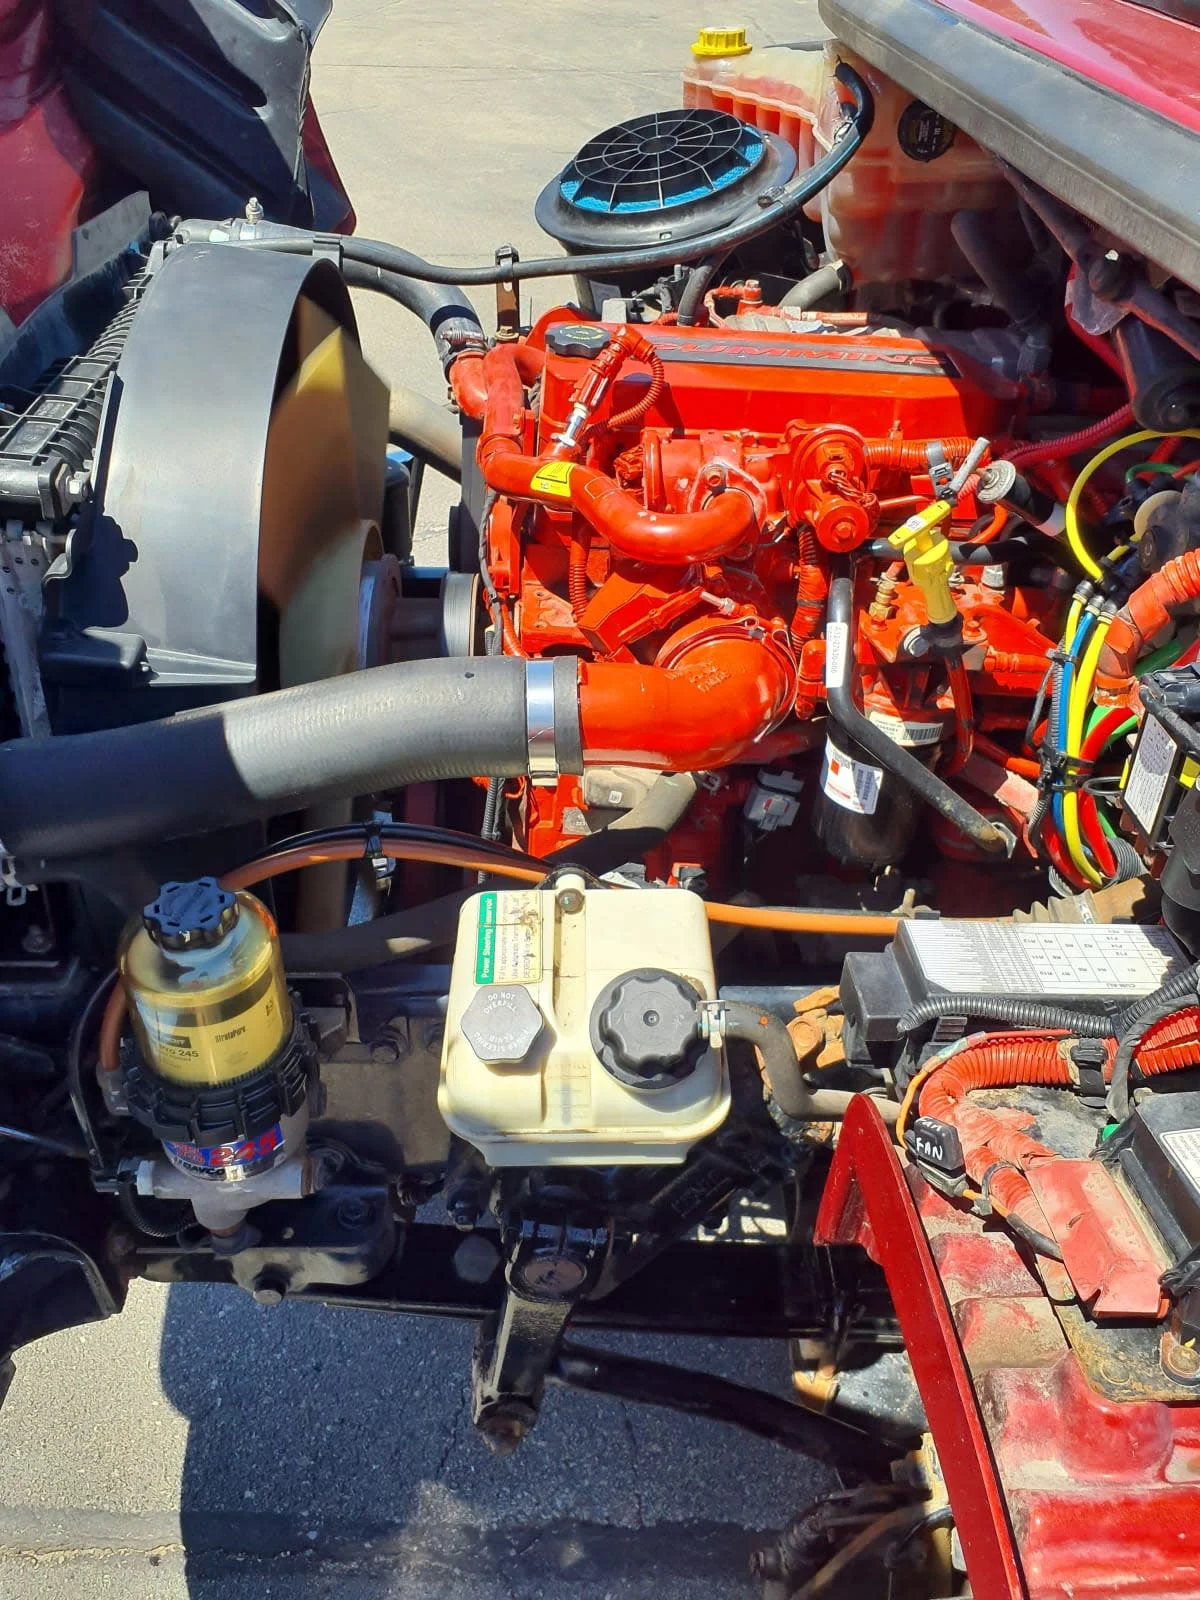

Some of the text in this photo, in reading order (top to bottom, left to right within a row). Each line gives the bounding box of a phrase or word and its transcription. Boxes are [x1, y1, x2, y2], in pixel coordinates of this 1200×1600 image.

[482, 928, 494, 956] Steering
[481, 957, 491, 979] Power
[482, 1000, 517, 1014] OVERFILL
[487, 991, 516, 1002] DO NOT
[177, 1049, 200, 1058] 245
[209, 1126, 278, 1167] 245
[916, 1137, 943, 1160] FAN
